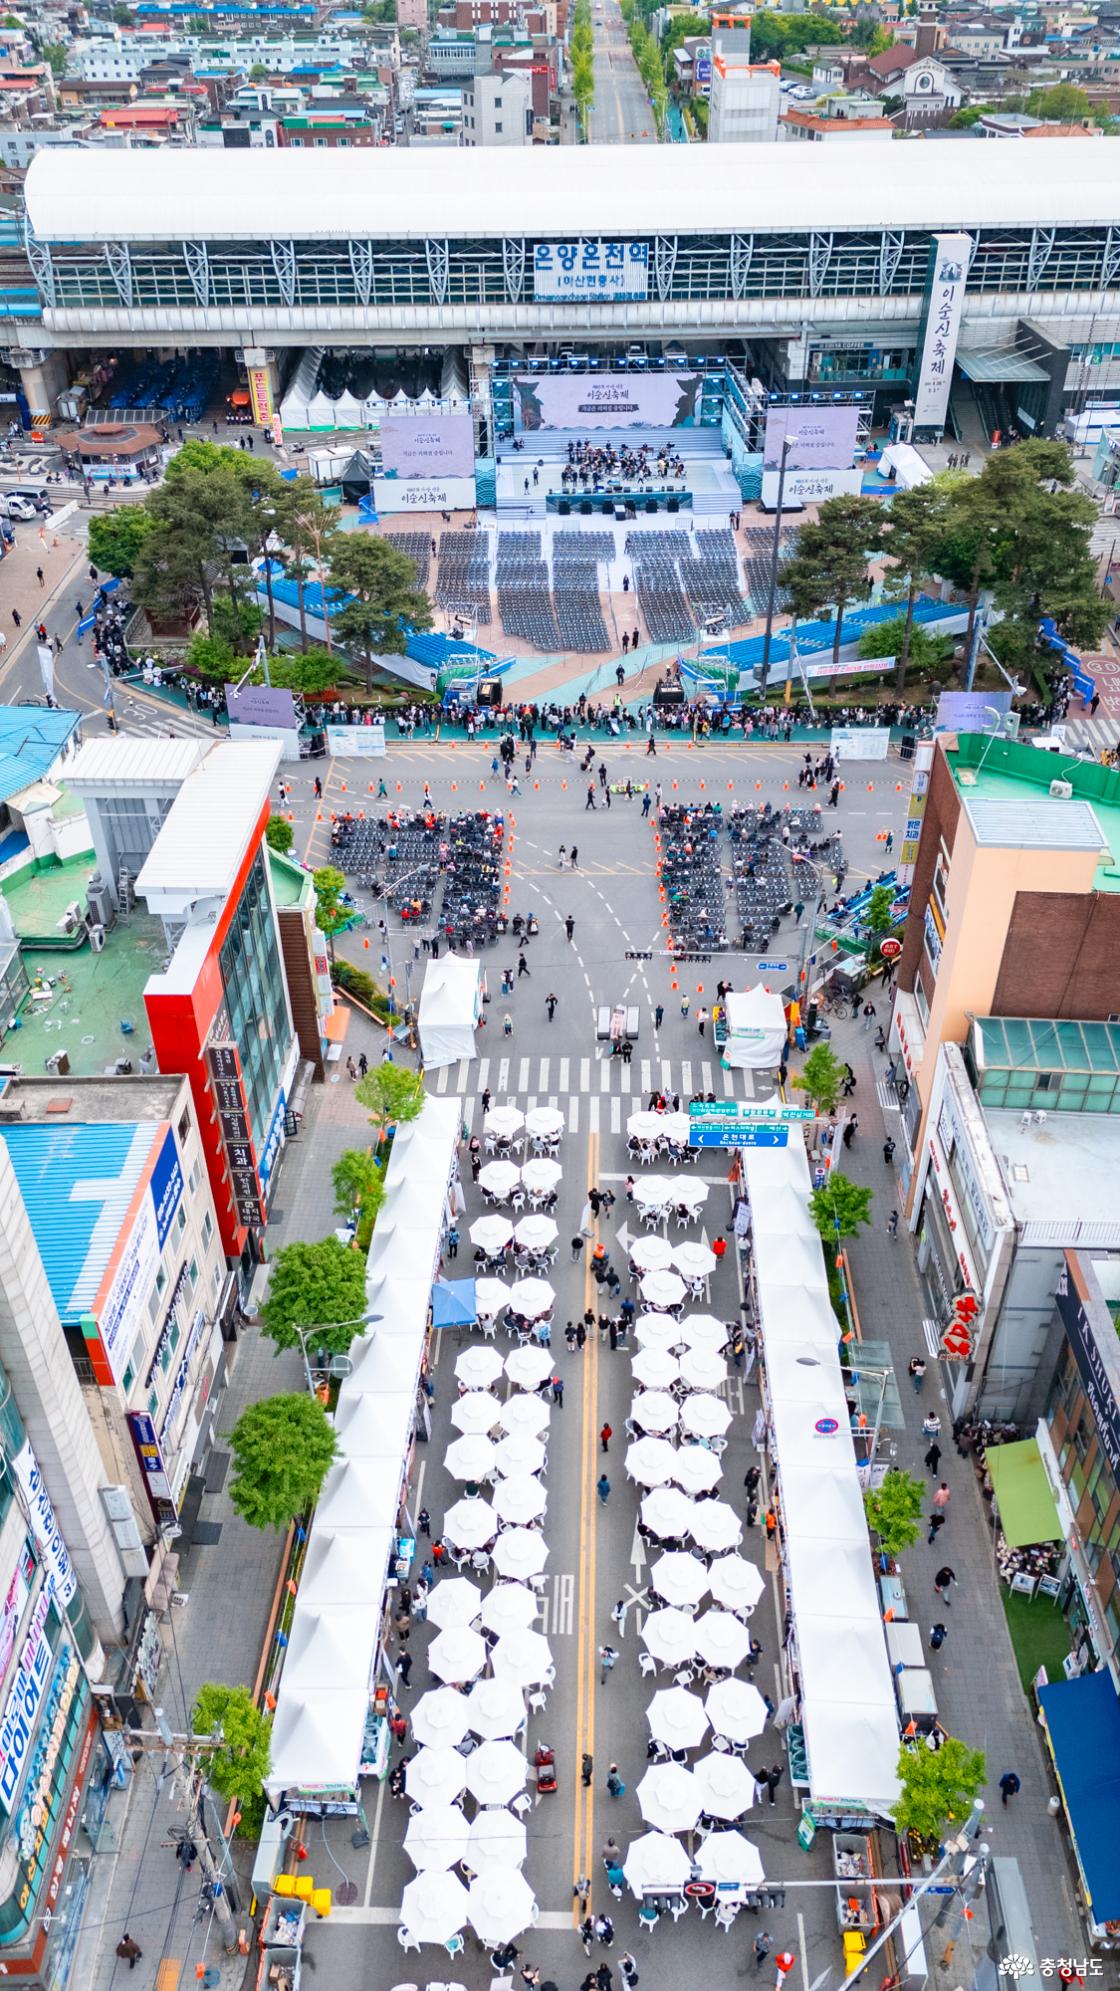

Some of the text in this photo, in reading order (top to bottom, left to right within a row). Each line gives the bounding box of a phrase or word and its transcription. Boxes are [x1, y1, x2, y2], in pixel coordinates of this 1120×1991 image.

[535, 243, 648, 271] 온양온천역
[930, 285, 955, 375] 이순신축제
[587, 390, 629, 400] 이순신축제
[788, 483, 834, 495] 이순신축제
[401, 492, 447, 504] 이순신축제
[907, 820, 920, 829] 밝은
[905, 830, 919, 839] 치과
[722, 1133, 755, 1141] 온천대로
[234, 1148, 248, 1166] 치과
[1, 1640, 50, 1801] 다이어트
